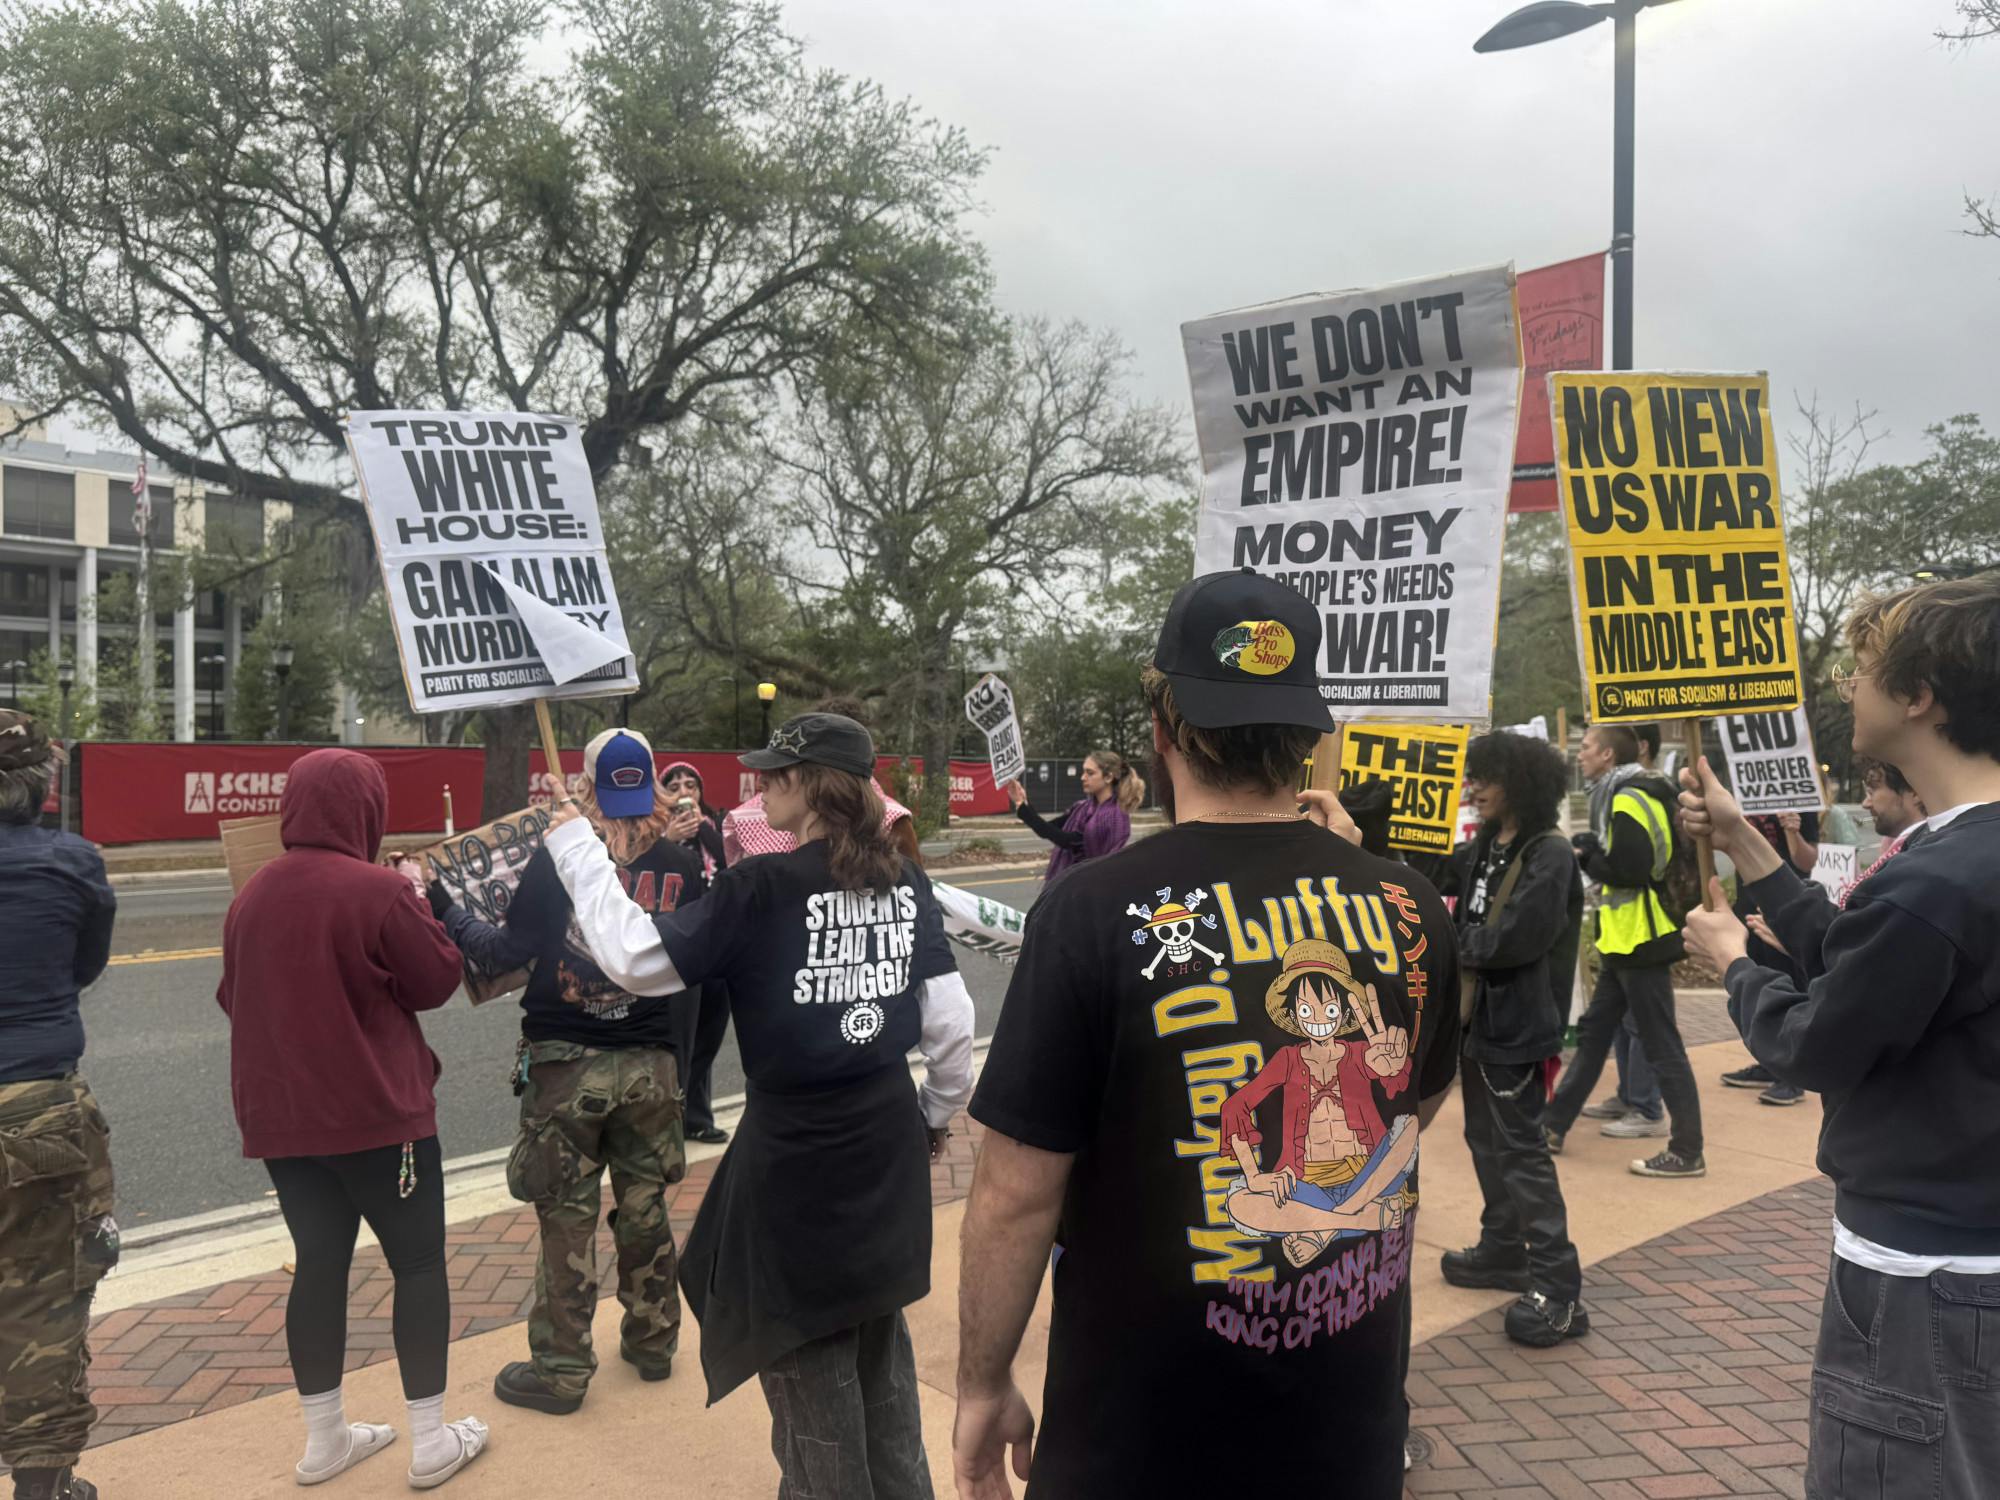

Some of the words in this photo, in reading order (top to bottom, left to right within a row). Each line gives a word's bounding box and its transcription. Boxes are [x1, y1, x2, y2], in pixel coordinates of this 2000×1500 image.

[1222, 321, 1303, 396] WE
[1311, 292, 1464, 383] DON'T
[1234, 380, 1385, 428] WANT
[1397, 367, 1472, 405] AN
[370, 420, 568, 447] TRUMP
[1562, 386, 1639, 469] NO
[1647, 387, 1764, 468] NEW
[1241, 405, 1468, 506] EMPIRE!
[401, 449, 565, 512] WHITE
[1570, 472, 1650, 534] US
[1650, 472, 1776, 531] WAR
[396, 514, 588, 544] HOUSE:
[1233, 508, 1463, 567] MONEY
[402, 560, 513, 620] GAN
[1383, 562, 1455, 604] NEEDS
[1582, 554, 1655, 608] IN
[1657, 551, 1784, 605] THE
[1254, 635, 1278, 651] Pro
[1255, 621, 1287, 638] Bass
[1326, 608, 1450, 673] WAR!
[1589, 610, 1707, 675] MIDDLE
[1710, 606, 1787, 668] EAST
[1251, 650, 1290, 669] Shops
[425, 676, 464, 694] PARTY
[466, 672, 490, 690] FOR
[1318, 685, 1371, 700] SOCIALISM
[1373, 686, 1380, 699] &
[1383, 684, 1440, 700] LIBERATION
[1624, 687, 1656, 708] PARTY
[1658, 685, 1678, 706] FOR
[1728, 683, 1737, 699] &
[1739, 680, 1795, 700] LIBERATION
[1349, 731, 1459, 777] THE
[1726, 711, 1797, 753] END
[217, 772, 288, 795] SCHE
[1735, 756, 1811, 784] FOREVER
[1738, 780, 1817, 798] WARS
[1389, 775, 1454, 821] EAST
[1388, 826, 1396, 838] &
[1398, 827, 1448, 845] LIBERATION
[427, 835, 493, 889] NO
[807, 926, 867, 967] LEAD
[873, 921, 915, 960] THE
[852, 1017, 874, 1032] SFS
[1152, 966, 1240, 1038] D.
[1296, 1237, 1377, 1312] GONNA
[1206, 1300, 1279, 1355] KING
[1283, 1308, 1321, 1349] OF
[1322, 1280, 1367, 1336] THE
